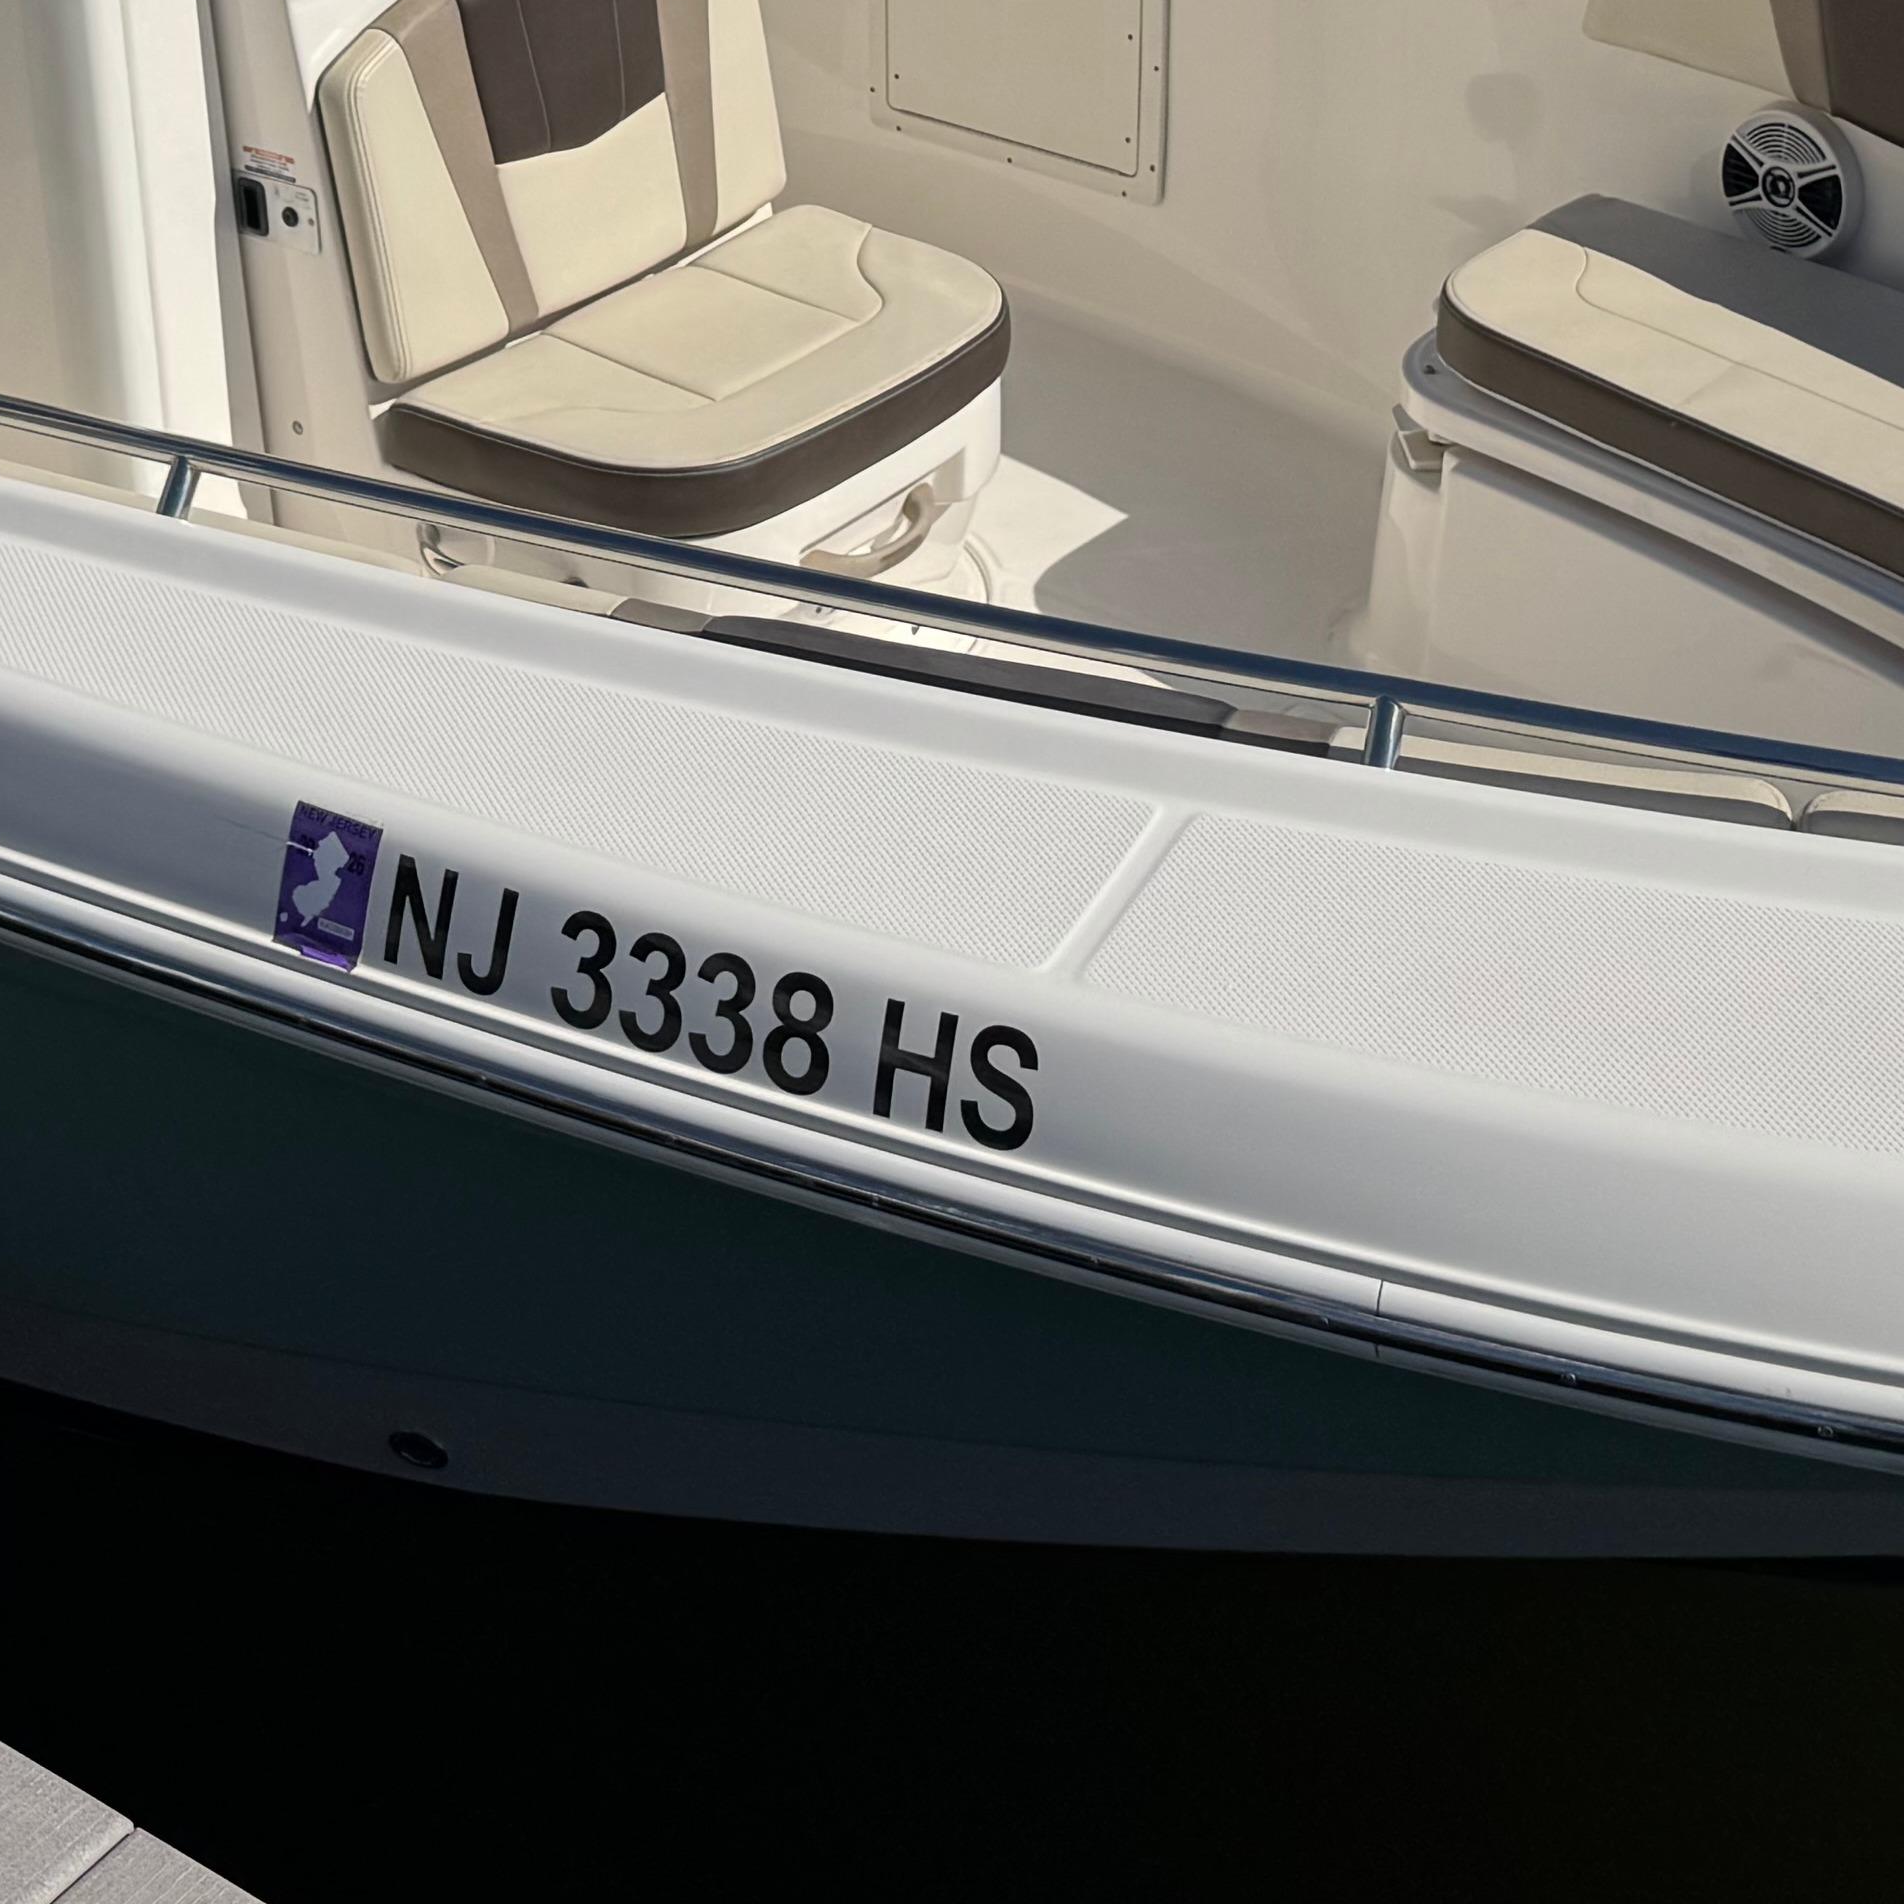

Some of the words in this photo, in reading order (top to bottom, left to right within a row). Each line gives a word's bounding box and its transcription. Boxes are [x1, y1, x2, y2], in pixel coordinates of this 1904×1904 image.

[299, 804, 328, 827] NEW
[329, 815, 377, 839] JERSEY
[348, 851, 366, 876] 26
[383, 854, 519, 996] NJ
[550, 910, 835, 1096] 3338
[872, 997, 1040, 1151] HS
